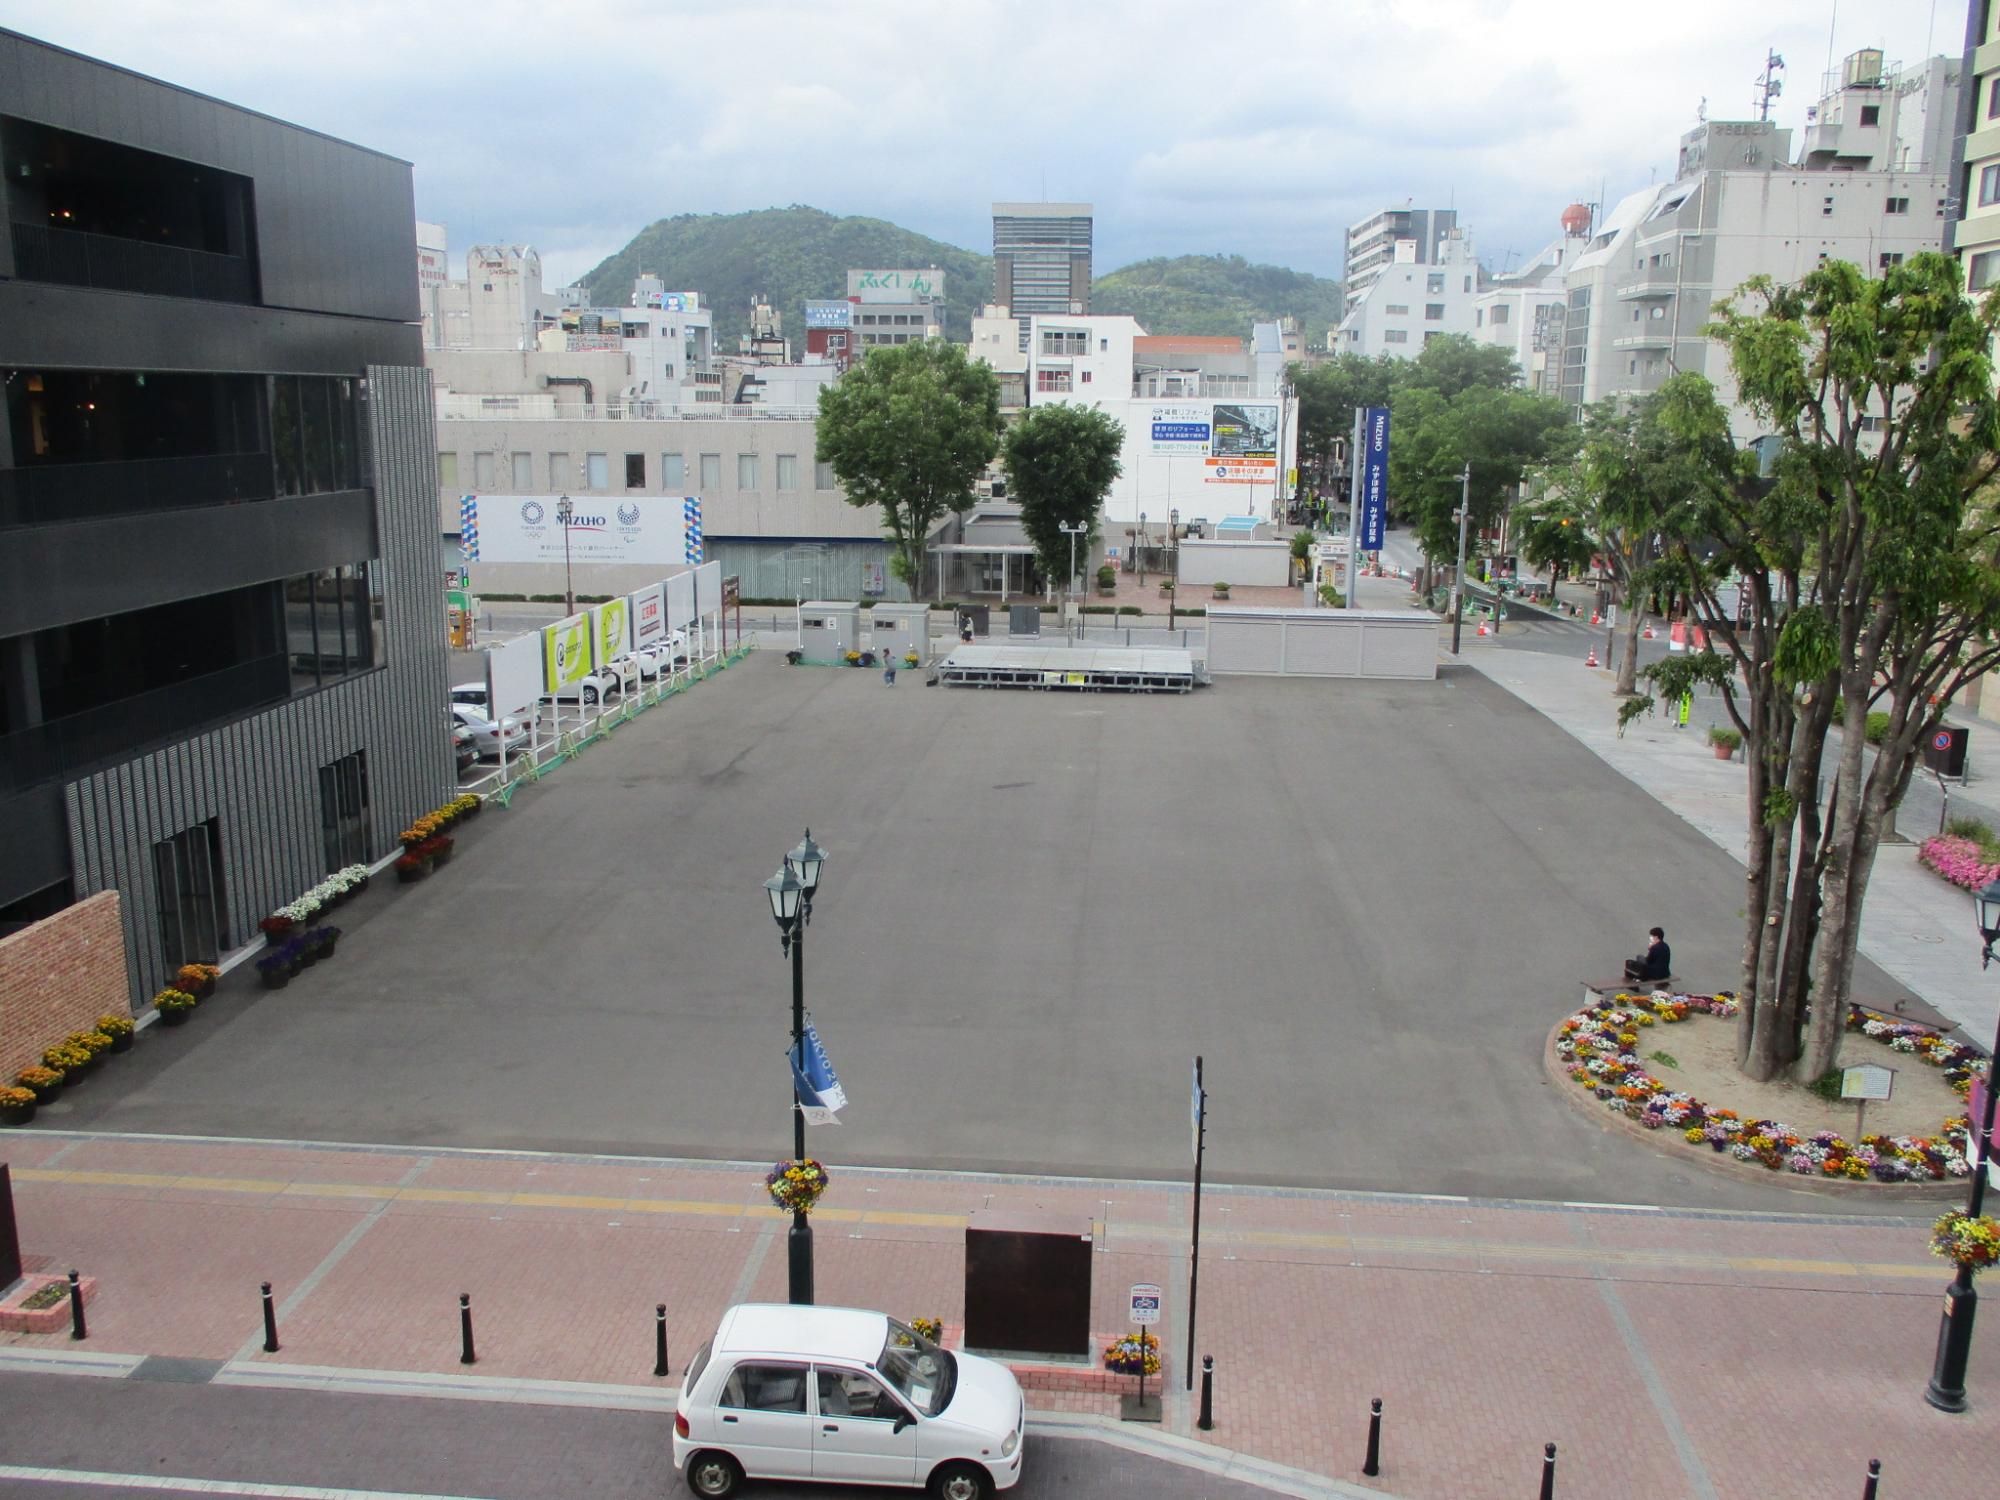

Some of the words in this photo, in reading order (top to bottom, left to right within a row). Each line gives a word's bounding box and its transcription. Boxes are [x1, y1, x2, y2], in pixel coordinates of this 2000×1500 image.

[859, 271, 932, 294] ふくしん
[1374, 415, 1385, 452] MIZUHO
[1370, 465, 1380, 502] みずほ銀行
[556, 514, 606, 526] MIZUHO
[1368, 507, 1378, 544] みずほ証券
